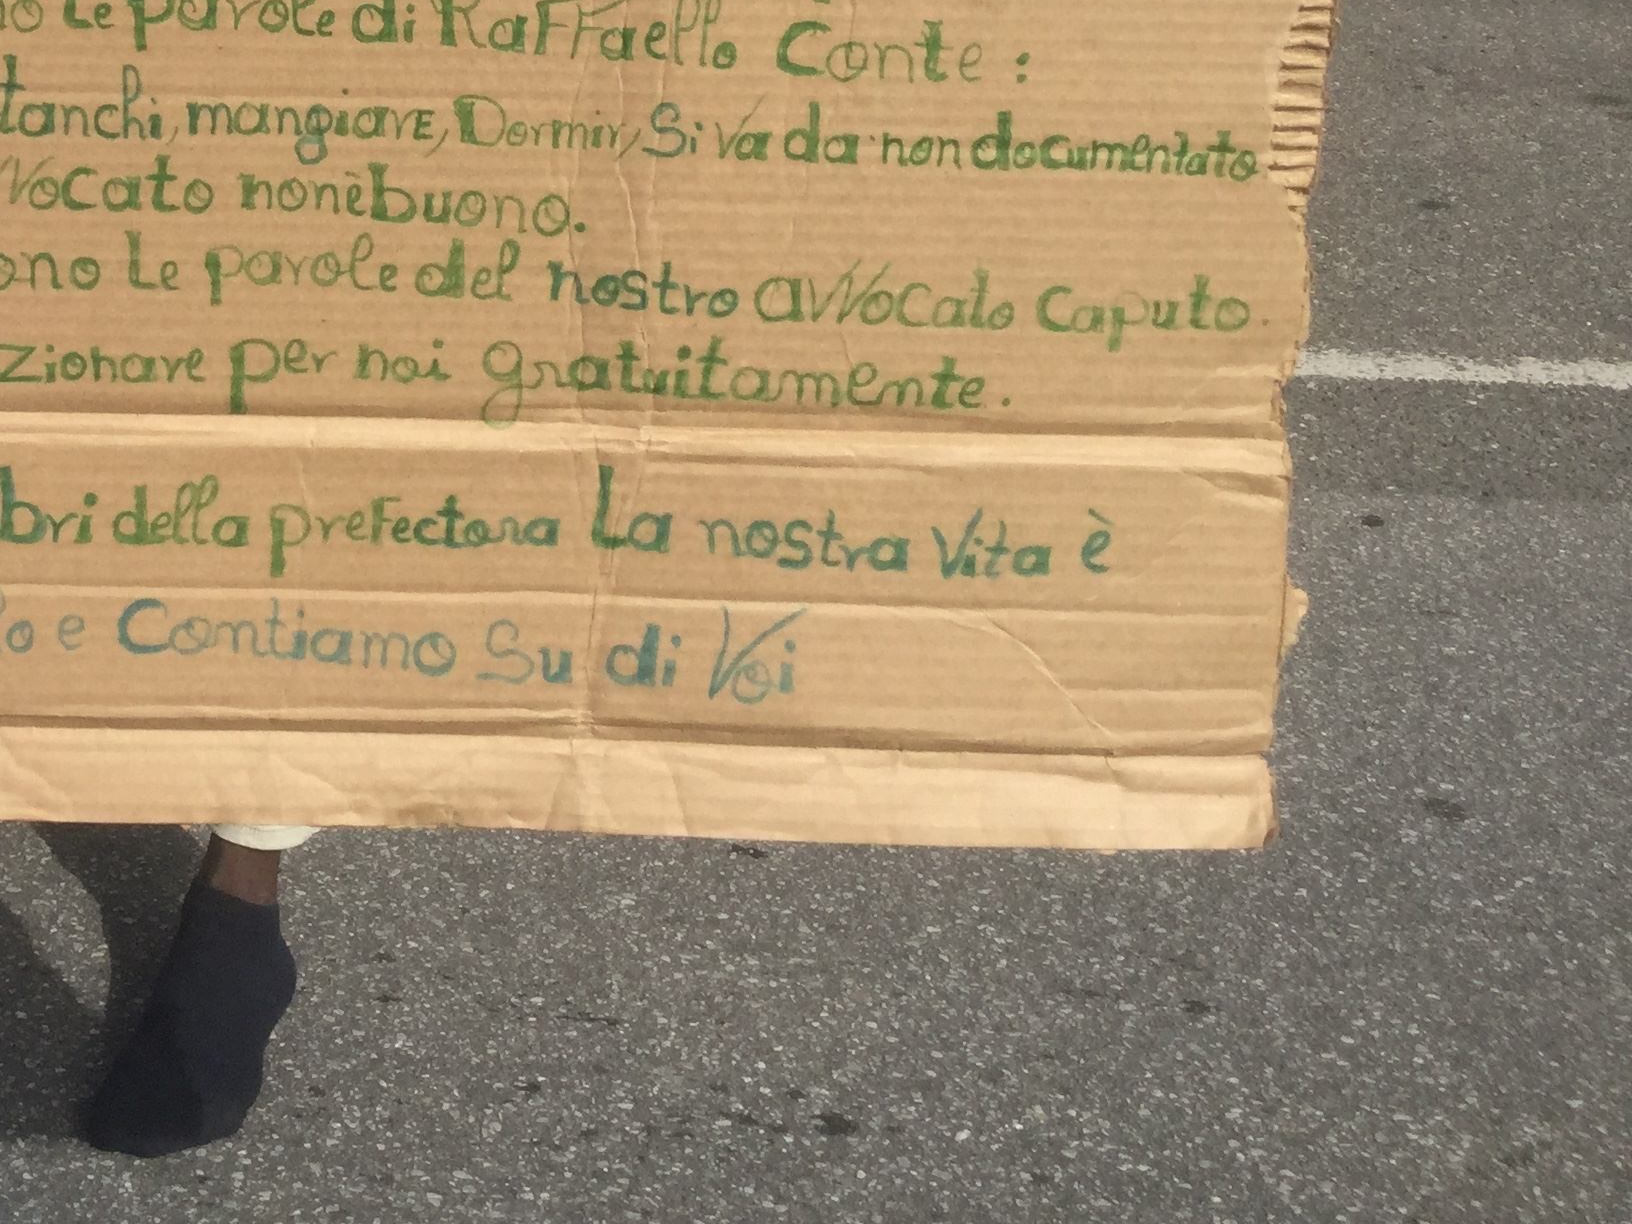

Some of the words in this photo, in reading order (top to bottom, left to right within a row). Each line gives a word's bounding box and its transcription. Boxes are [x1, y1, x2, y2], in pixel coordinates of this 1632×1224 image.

[204, 232, 398, 306] parole
[414, 237, 522, 302] del
[548, 259, 739, 318] nostro
[229, 338, 344, 415] per
[354, 338, 453, 385] noi
[111, 474, 251, 548] della
[698, 508, 913, 574] nostra
[1079, 507, 1115, 574] è
[57, 612, 87, 653] e
[604, 623, 684, 688] di
[708, 607, 809, 706] Voi
